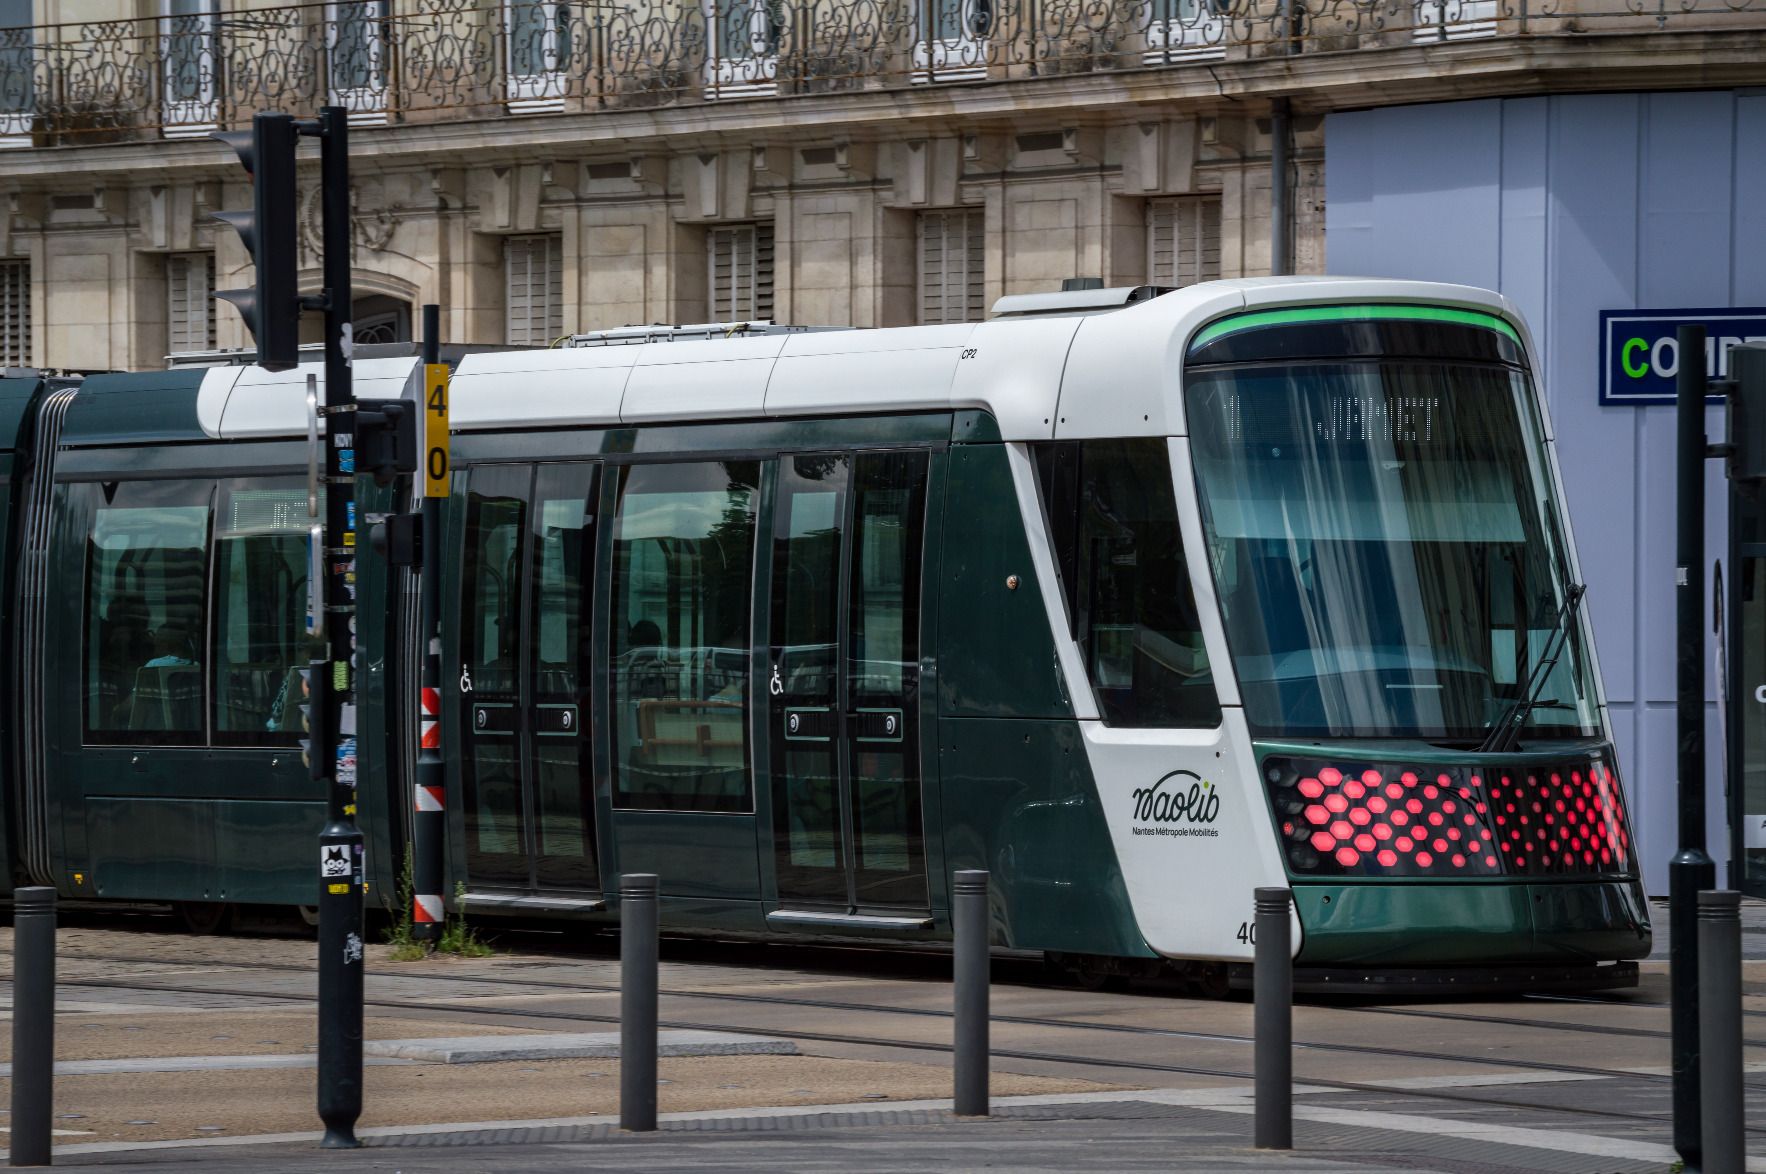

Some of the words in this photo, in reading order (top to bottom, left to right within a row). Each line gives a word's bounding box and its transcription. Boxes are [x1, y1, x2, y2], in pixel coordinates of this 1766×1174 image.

[961, 348, 978, 360] CP2
[1132, 769, 1220, 823] naolib
[1132, 826, 1155, 836] Nantes
[1155, 826, 1189, 838] Métropole
[1189, 827, 1219, 837] Mobilités
